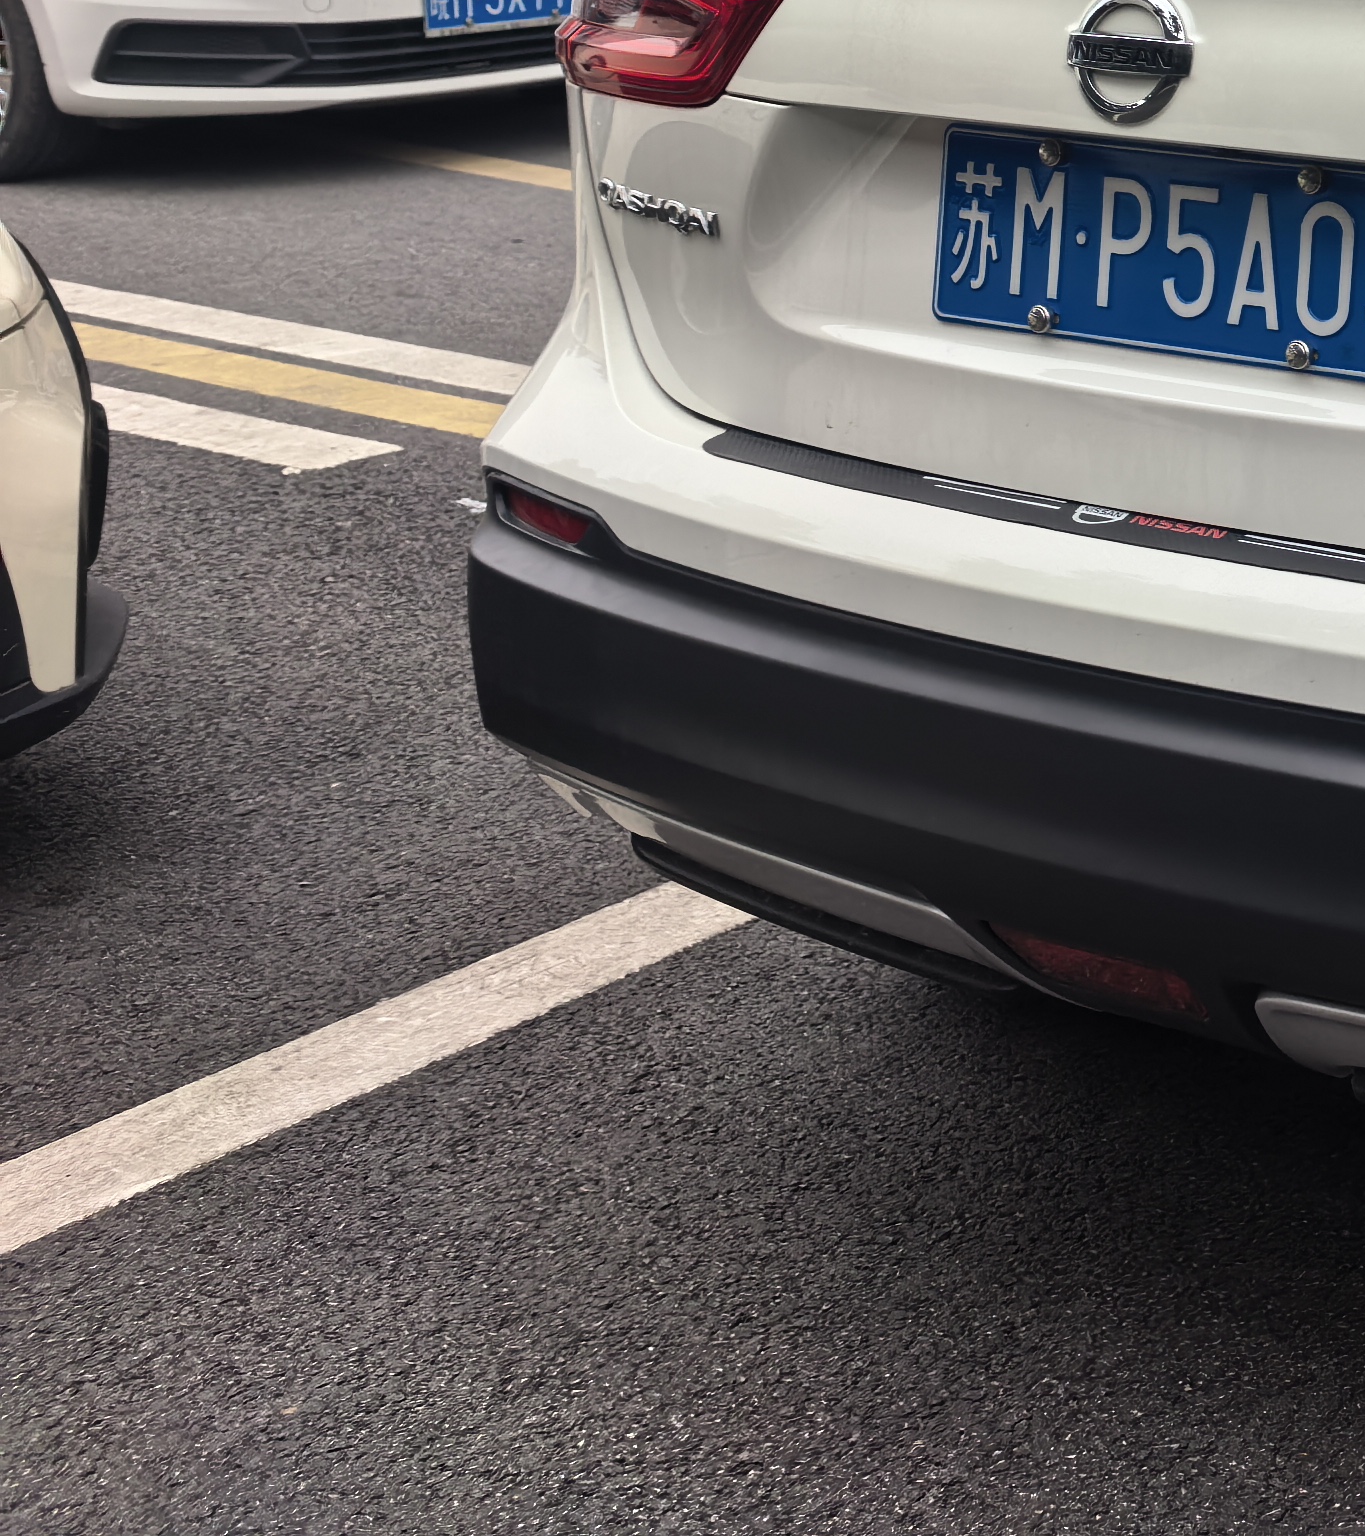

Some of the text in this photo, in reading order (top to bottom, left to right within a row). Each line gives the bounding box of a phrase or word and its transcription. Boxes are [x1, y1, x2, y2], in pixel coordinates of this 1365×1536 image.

[1072, 40, 1176, 70] NISSAN
[598, 177, 720, 238] QASHQAI
[1082, 505, 1124, 518] NISSAN
[1129, 515, 1228, 539] NISSAN
